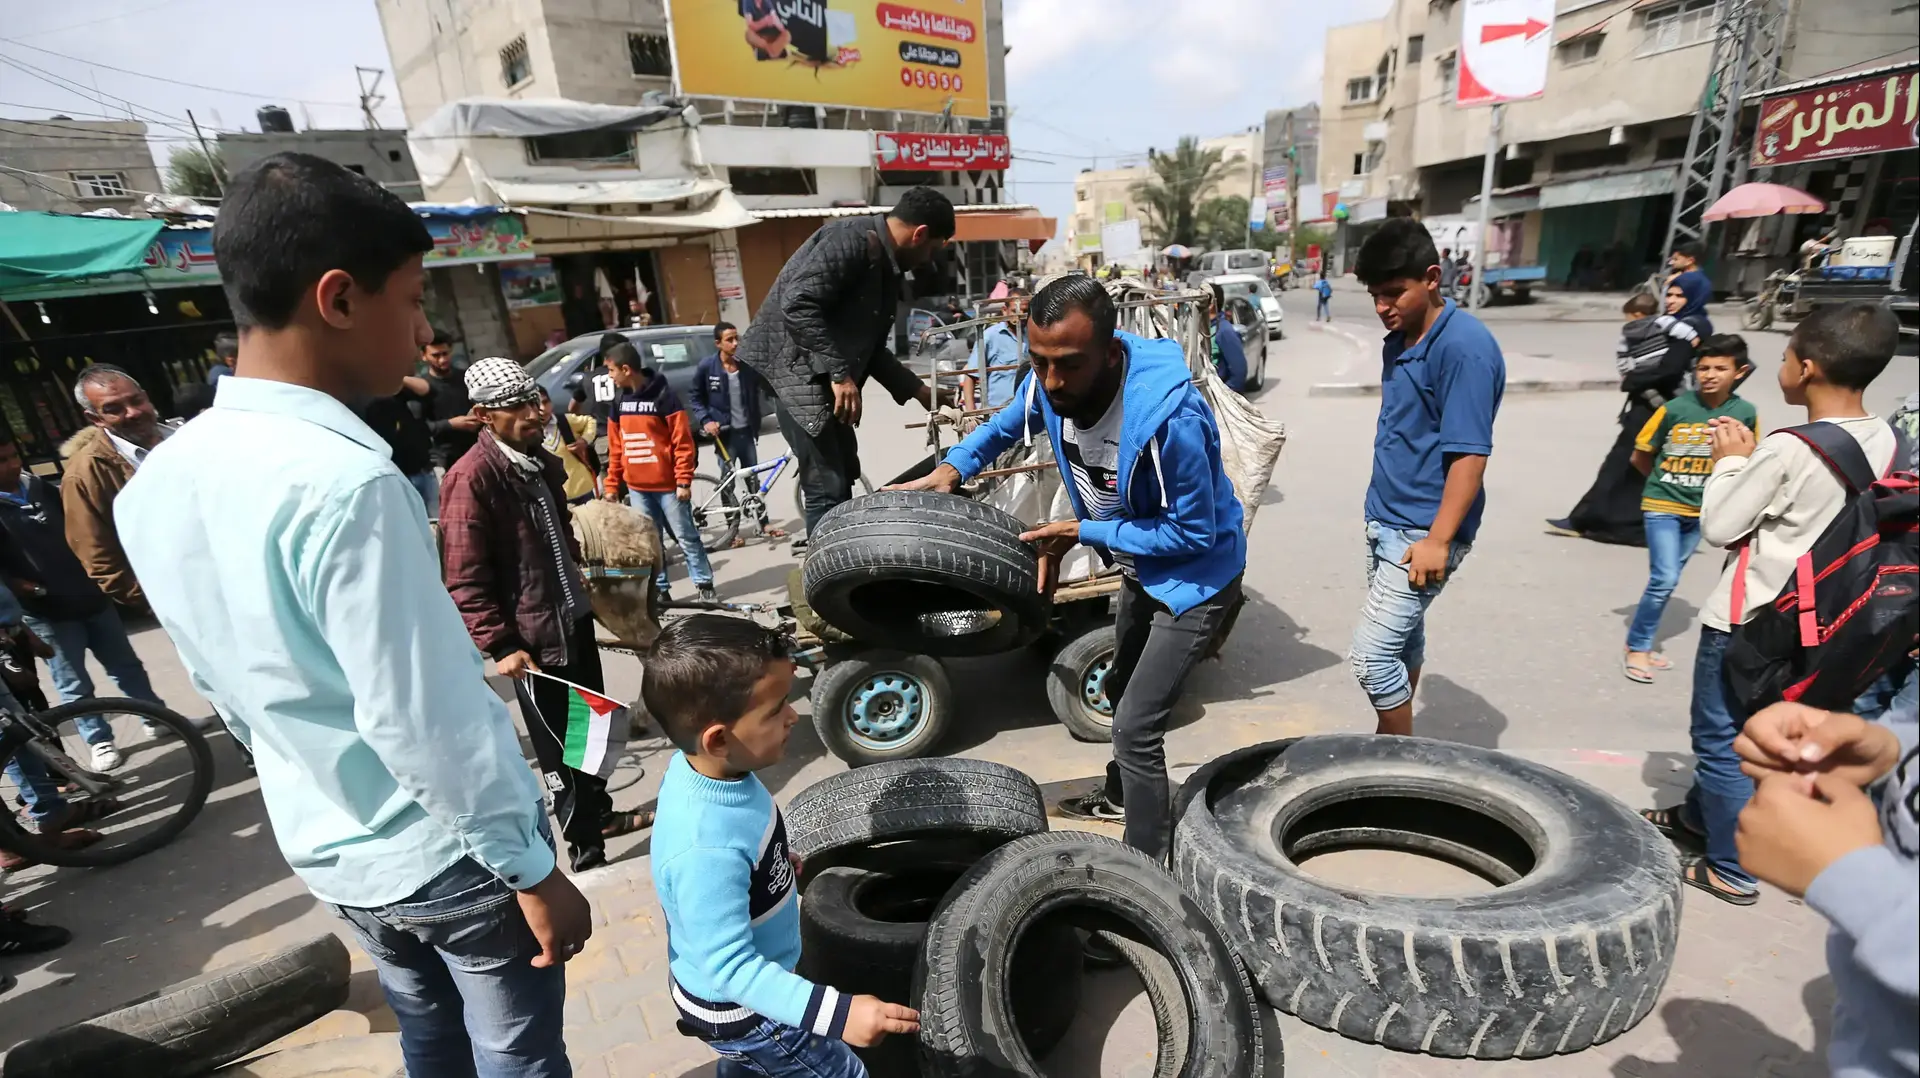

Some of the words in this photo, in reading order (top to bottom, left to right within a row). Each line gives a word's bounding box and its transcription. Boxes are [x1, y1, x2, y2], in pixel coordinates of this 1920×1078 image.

[885, 10, 920, 29] كبير
[921, 13, 930, 33] يا
[592, 374, 615, 402] 13
[621, 401, 637, 412] NEW
